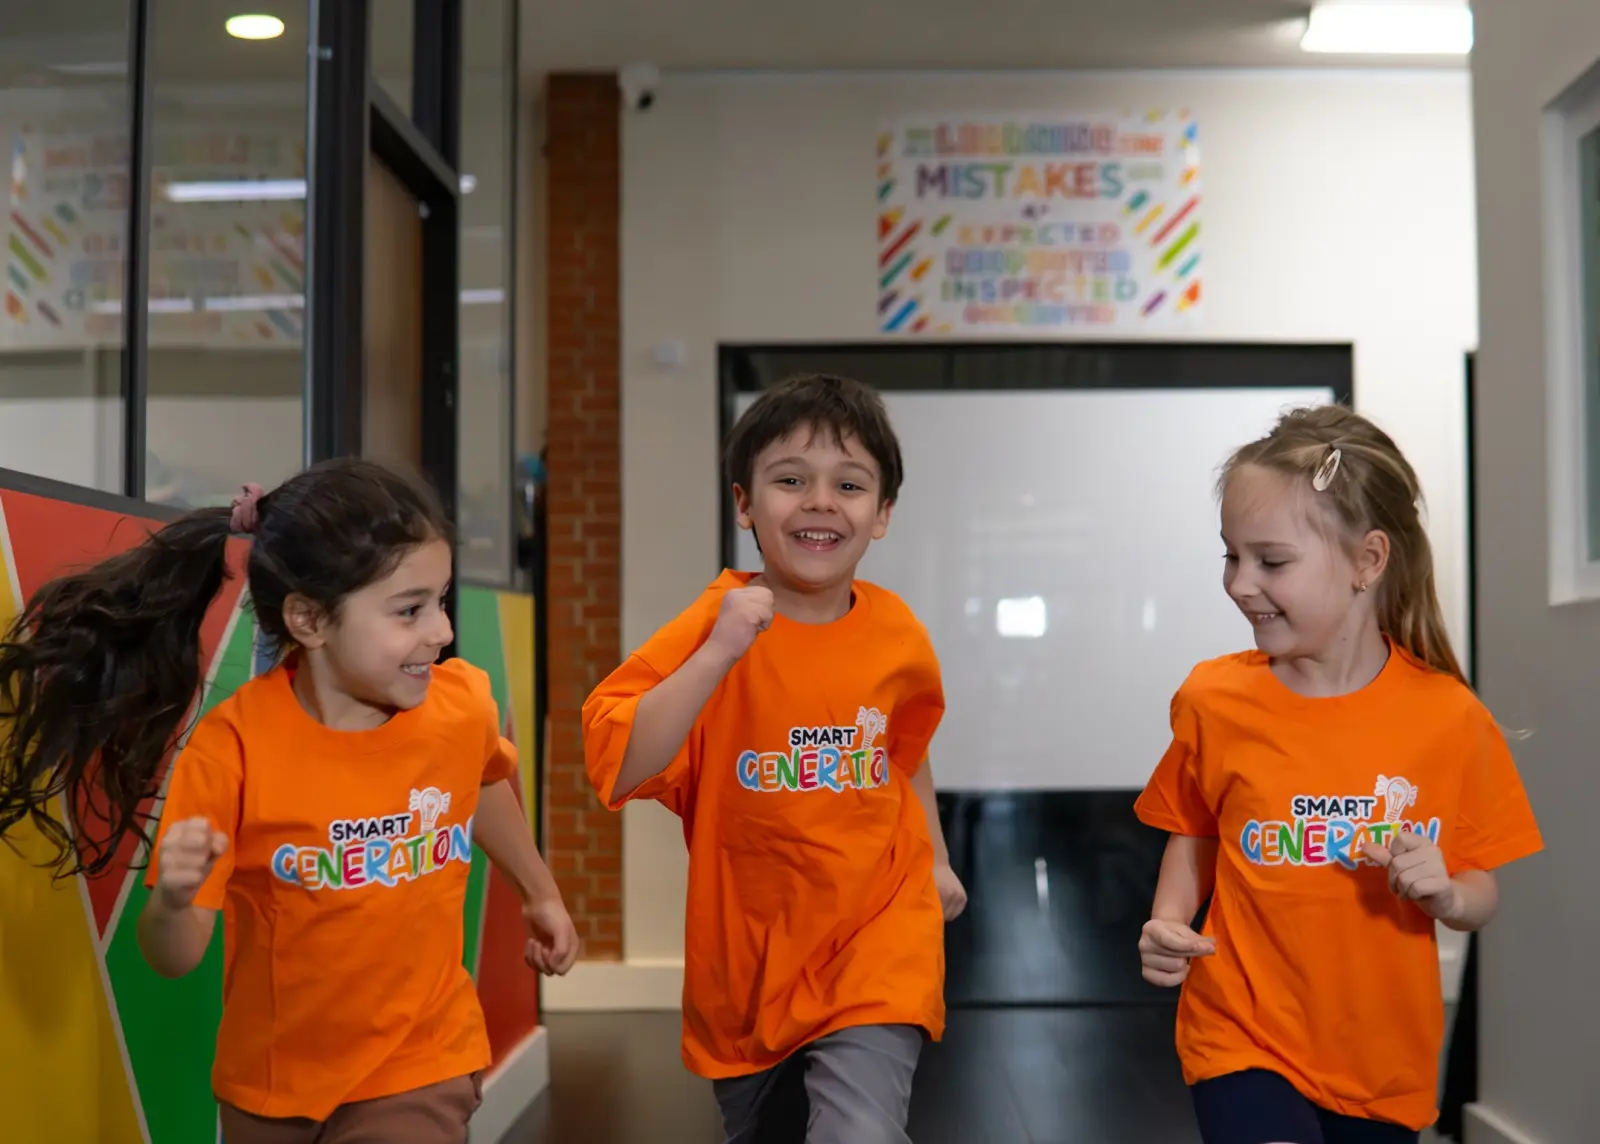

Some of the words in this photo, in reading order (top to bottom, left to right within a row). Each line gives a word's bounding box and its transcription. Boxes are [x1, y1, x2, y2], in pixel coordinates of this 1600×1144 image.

[916, 163, 1123, 198] MISTAKES
[790, 728, 856, 746] SMART
[1293, 796, 1375, 817] SMART
[331, 814, 412, 842] SMART
[272, 817, 473, 890] GENERATION
